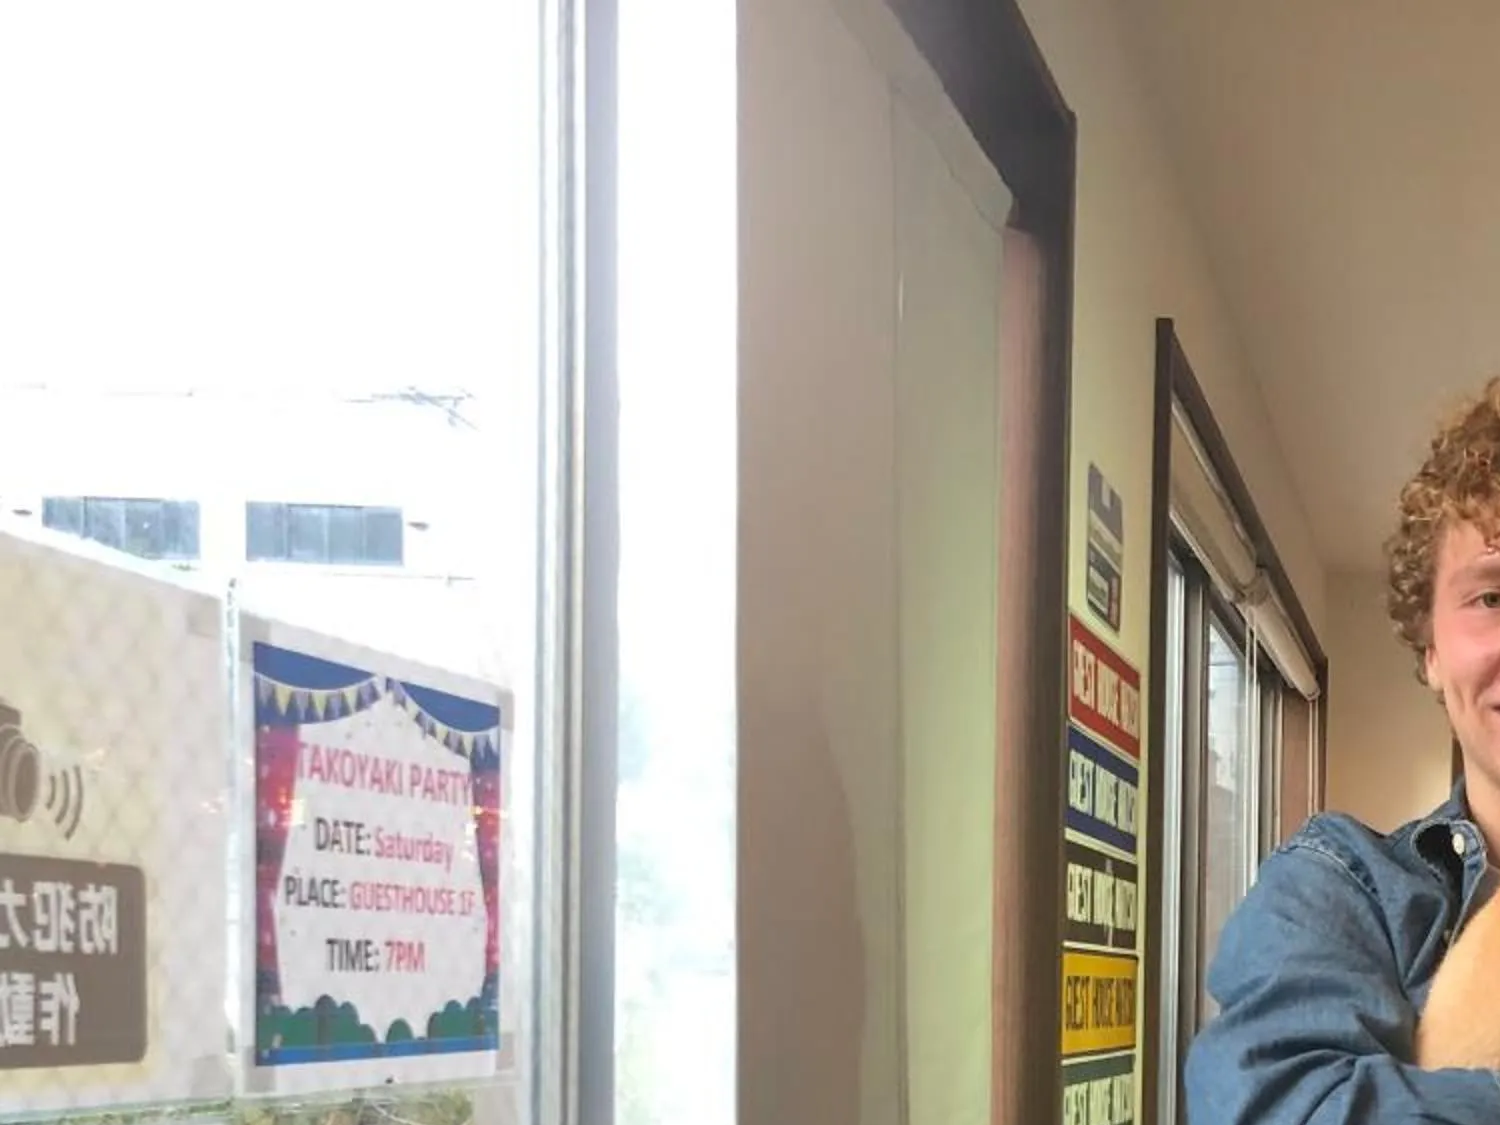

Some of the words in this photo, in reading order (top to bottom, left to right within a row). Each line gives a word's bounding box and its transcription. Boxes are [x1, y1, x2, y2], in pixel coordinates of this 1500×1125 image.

[298, 741, 404, 796] TAKOYAKI
[410, 762, 474, 807] PARTY
[315, 816, 372, 856] DATE:
[374, 826, 455, 873] Saturday
[284, 875, 347, 909] PLACE:
[351, 882, 455, 916] GUESTHOUSE
[326, 938, 379, 972] TIME:
[385, 940, 426, 972] 7PM
